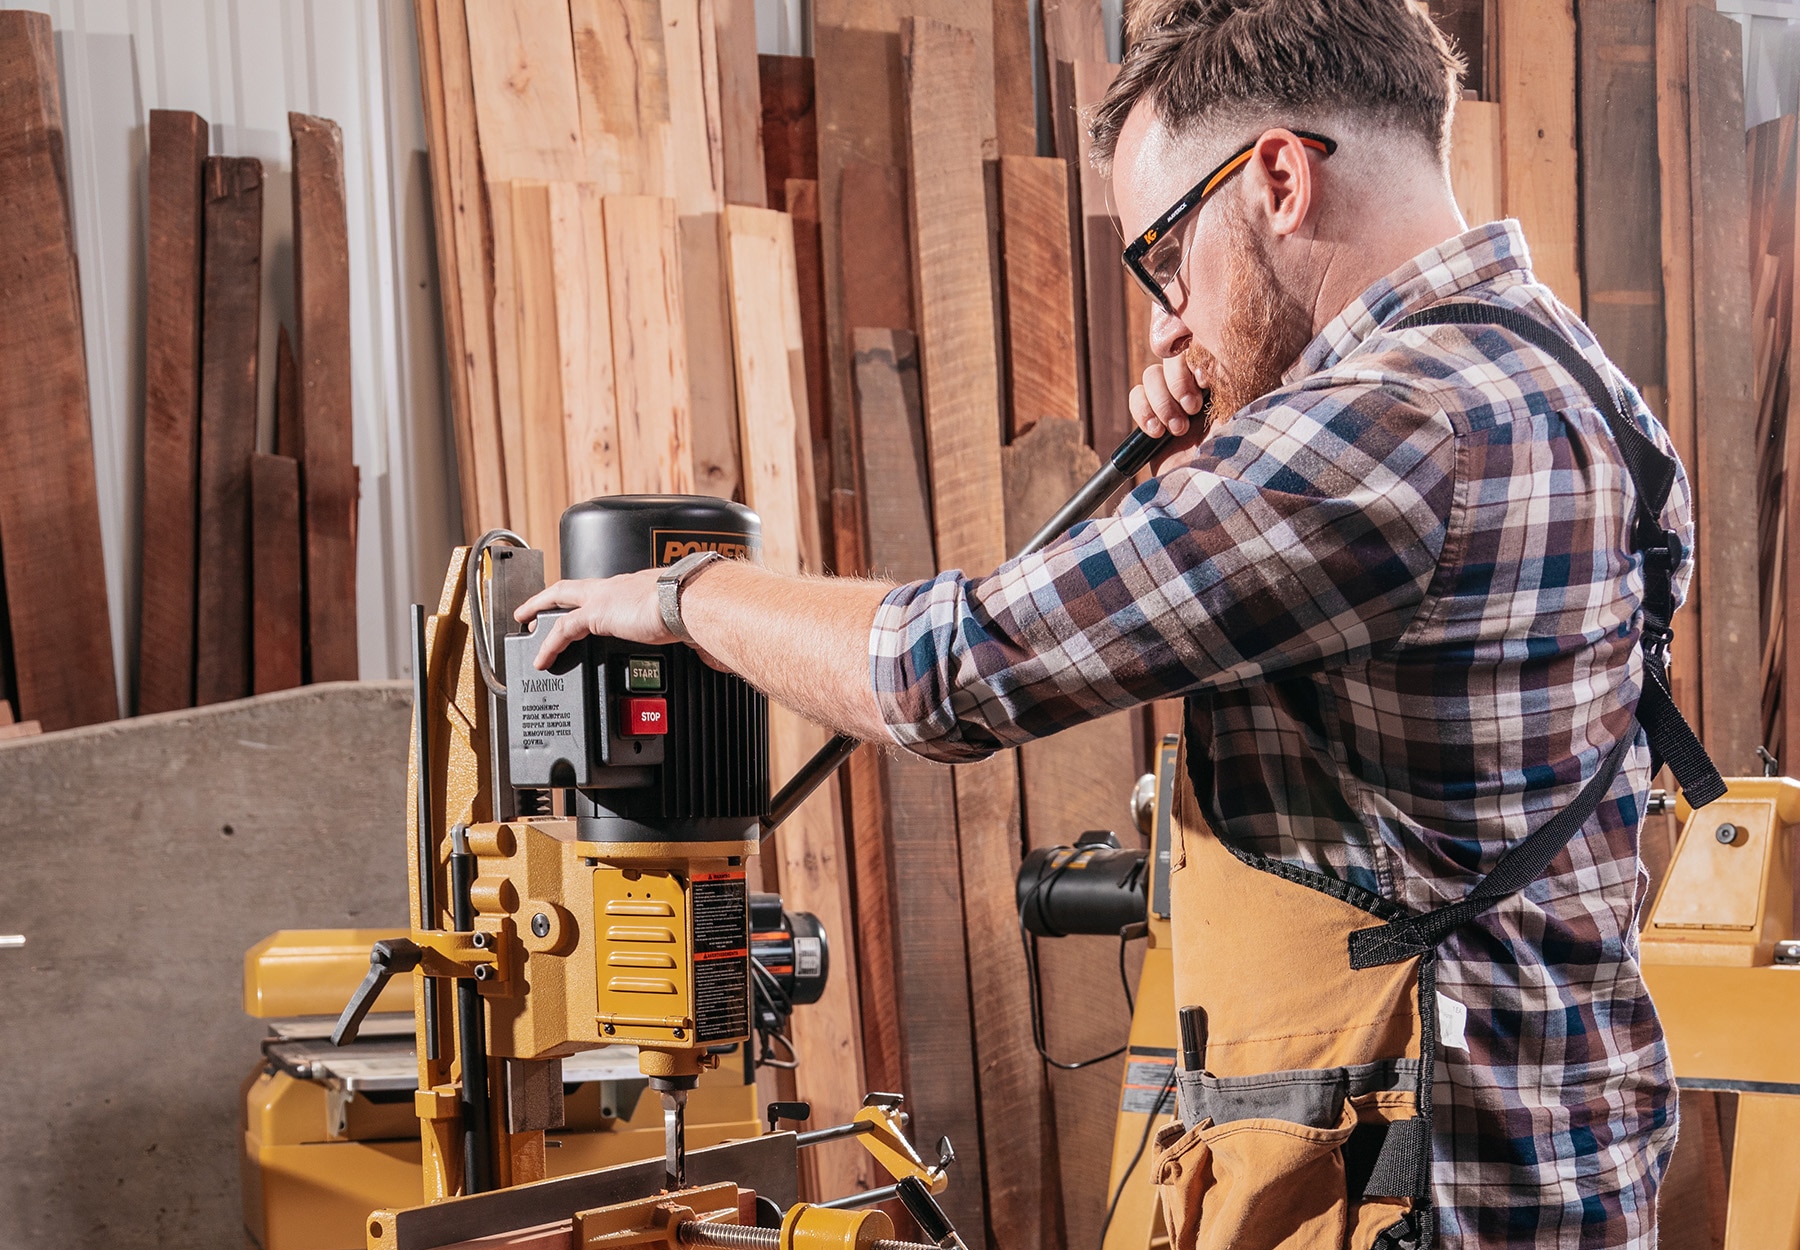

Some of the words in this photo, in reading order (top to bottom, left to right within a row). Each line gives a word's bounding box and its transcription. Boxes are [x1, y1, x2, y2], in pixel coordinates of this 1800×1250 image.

[663, 541, 751, 563] POWER
[633, 668, 658, 678] START
[522, 678, 564, 693] WARNING
[641, 711, 661, 722] STOP
